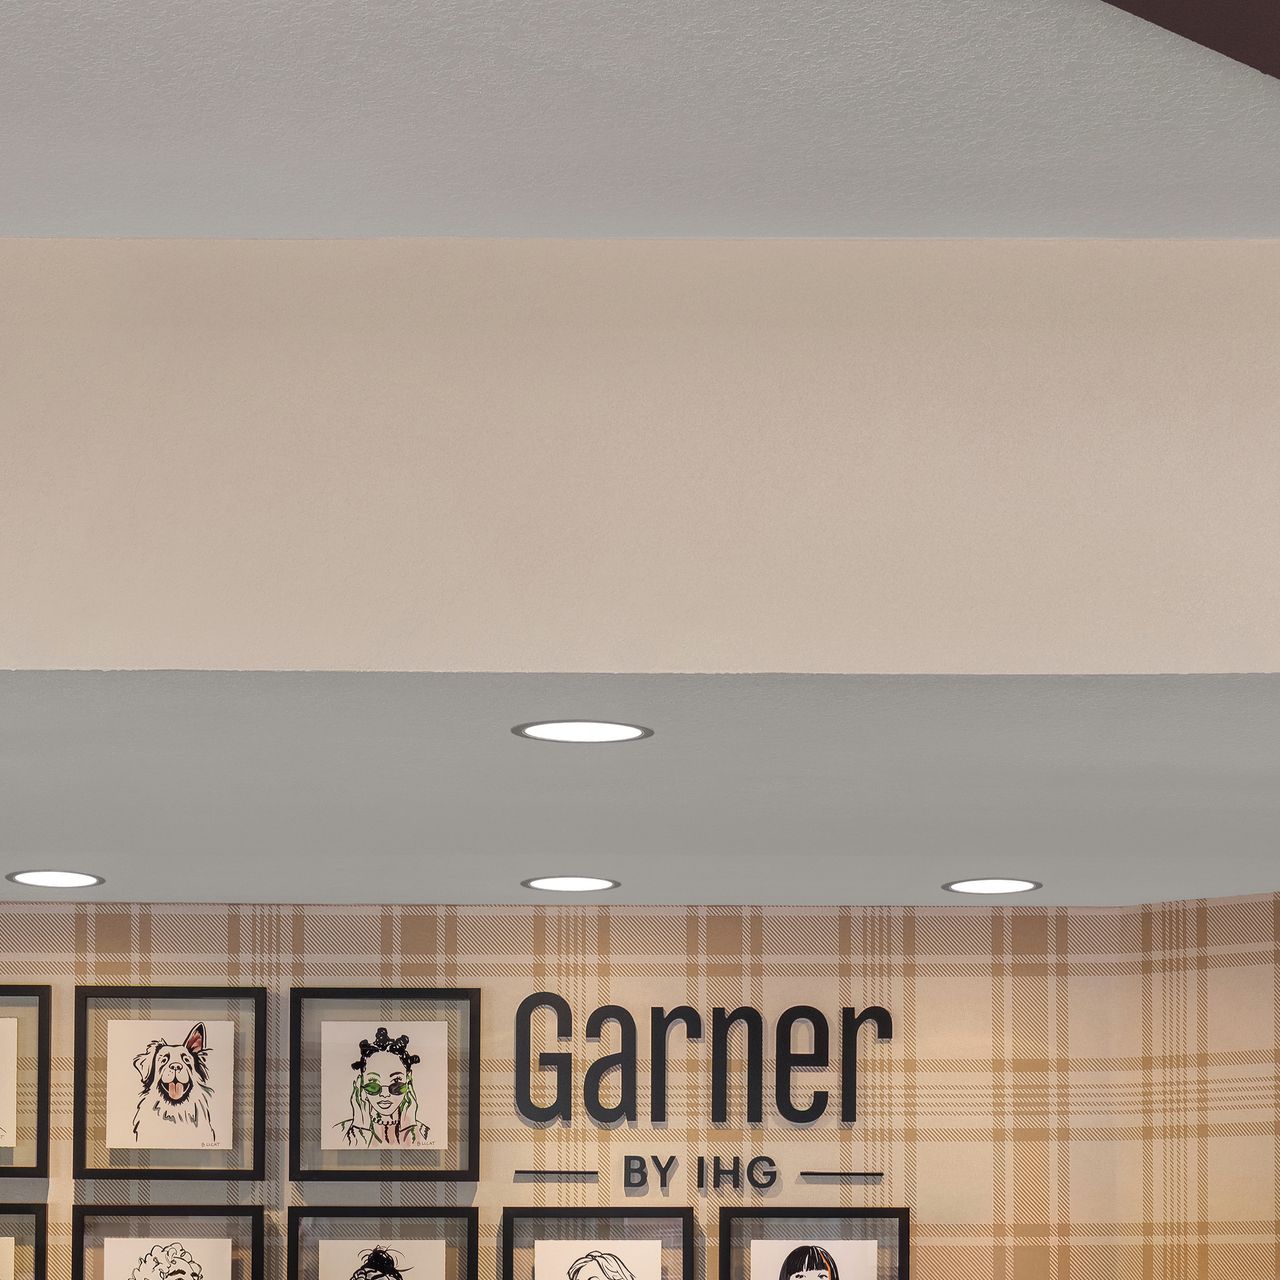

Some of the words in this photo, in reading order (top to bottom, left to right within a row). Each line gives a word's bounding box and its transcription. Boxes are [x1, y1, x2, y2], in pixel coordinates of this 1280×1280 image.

[515, 991, 893, 1123] Garner
[624, 1155, 677, 1188] BY
[697, 1156, 778, 1189] IHG
